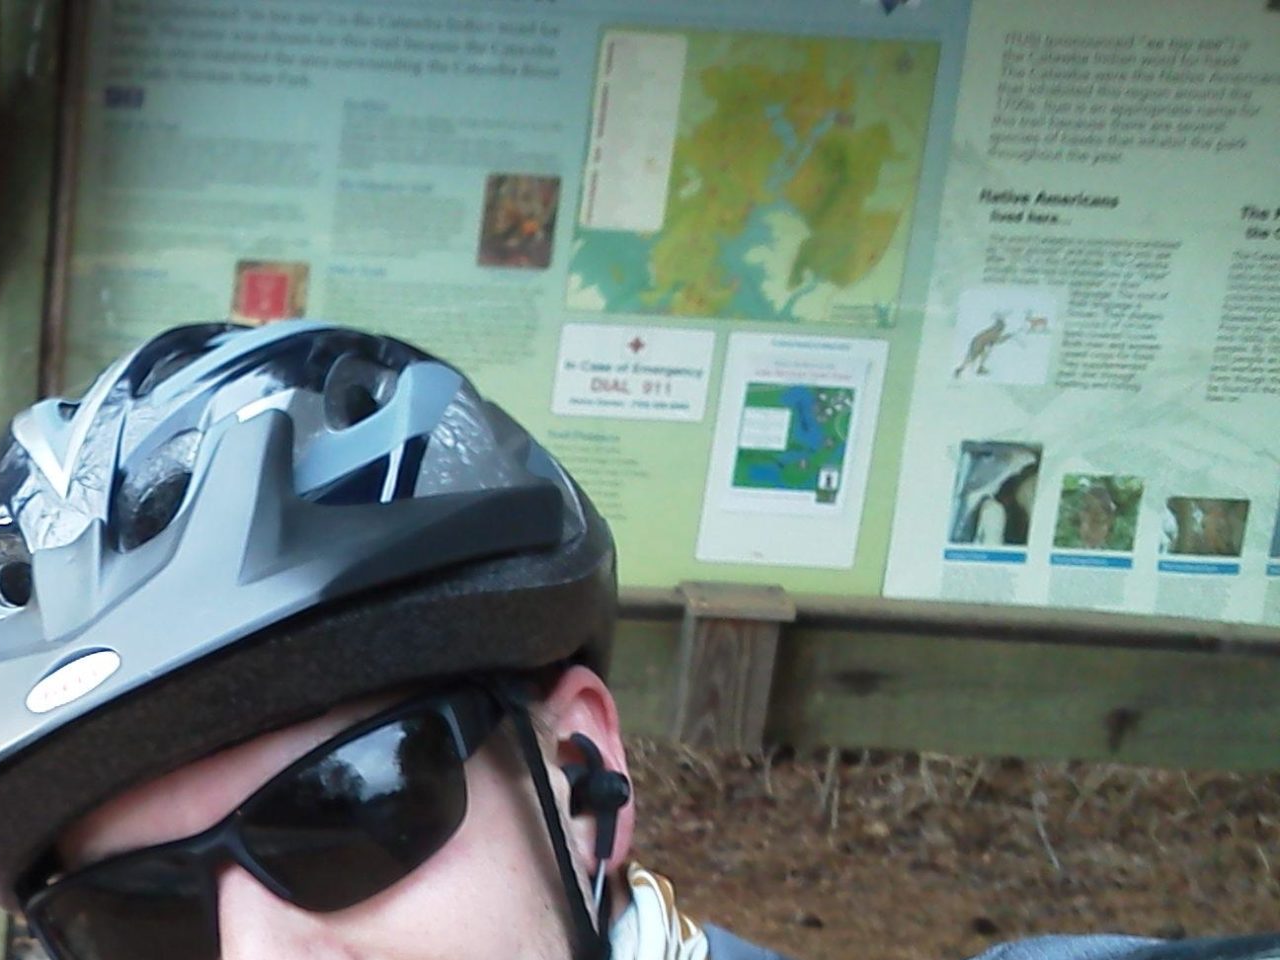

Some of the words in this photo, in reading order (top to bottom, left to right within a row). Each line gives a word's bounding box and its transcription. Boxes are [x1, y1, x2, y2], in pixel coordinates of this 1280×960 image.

[980, 188, 1030, 206] Native
[1034, 190, 1119, 209] Americans
[580, 359, 612, 373] Case
[632, 362, 704, 380] Emergency
[590, 377, 630, 396] DIAL
[641, 380, 673, 397] 911
